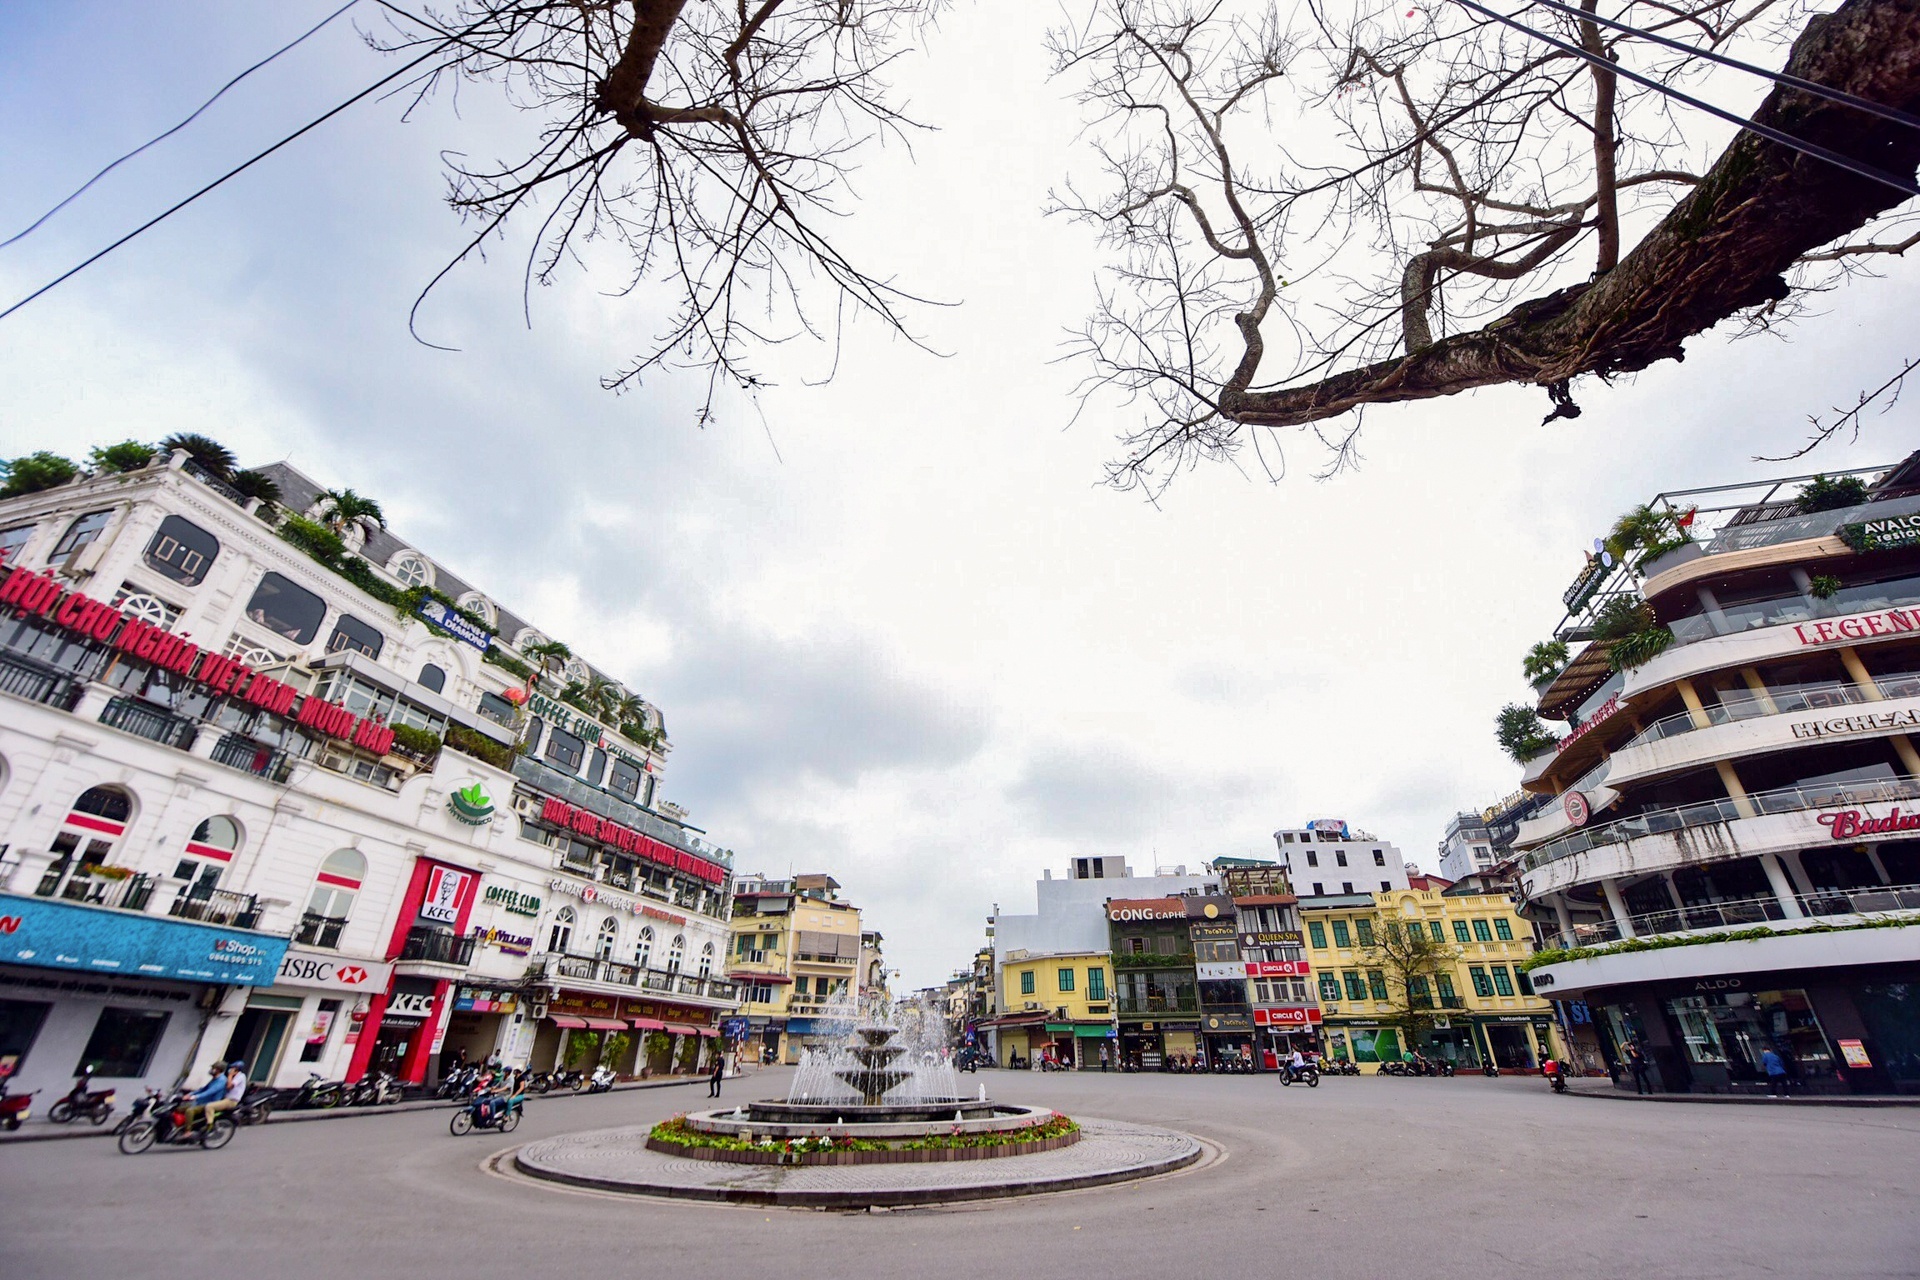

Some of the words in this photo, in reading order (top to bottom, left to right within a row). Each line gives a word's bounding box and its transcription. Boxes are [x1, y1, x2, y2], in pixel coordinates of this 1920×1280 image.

[444, 619, 488, 648] DIAMOND
[453, 614, 487, 639] MINH
[244, 672, 298, 716] NAM
[528, 692, 572, 729] COFFEE
[573, 717, 602, 744] CLUB
[486, 886, 519, 906] COFFEE
[520, 894, 541, 911] CLUB
[427, 907, 454, 920] KFC
[1111, 907, 1153, 923] CỘNG
[1156, 911, 1187, 919] CAPHE
[1258, 933, 1284, 942] QUEEN
[1695, 979, 1741, 990] ALDO
[387, 993, 435, 1012] KFC
